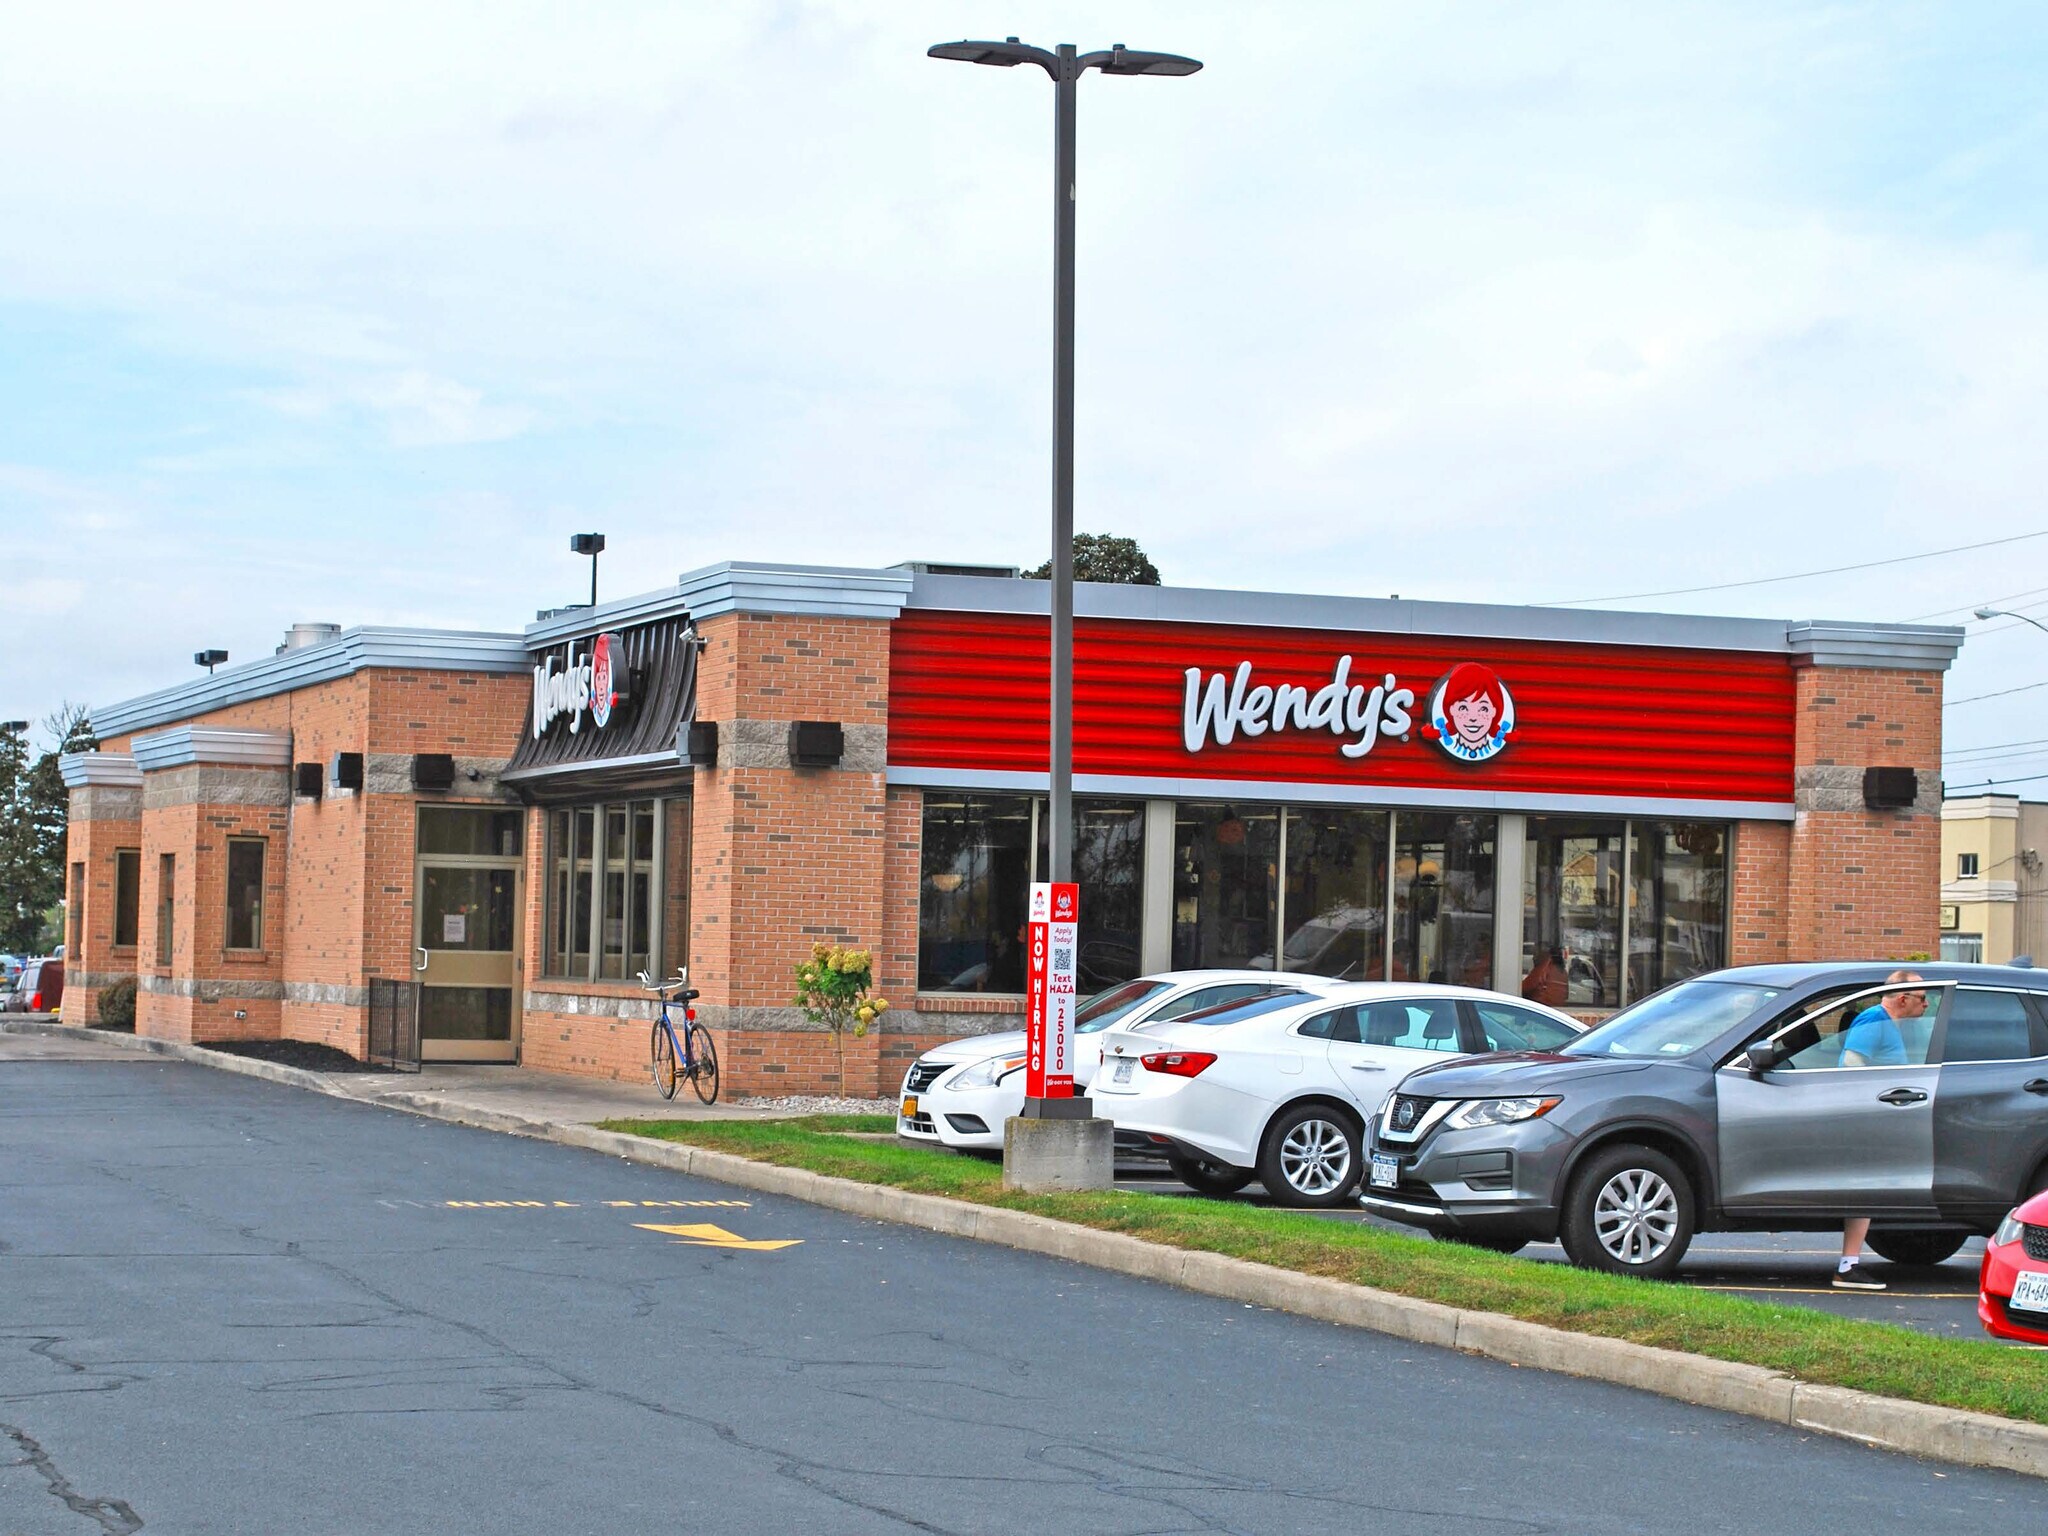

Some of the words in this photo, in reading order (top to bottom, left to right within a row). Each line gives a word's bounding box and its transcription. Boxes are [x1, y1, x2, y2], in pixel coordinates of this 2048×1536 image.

[533, 640, 591, 740] Wendy's
[1184, 655, 1415, 758] Wendy's
[1033, 926, 1043, 972] NOW
[1053, 936, 1073, 944] Today!
[1055, 927, 1072, 935] Apply
[1049, 985, 1074, 994] HAZA
[1053, 973, 1071, 983] Text
[1031, 978, 1041, 1071] HIRING
[1056, 1008, 1064, 1070] 25000
